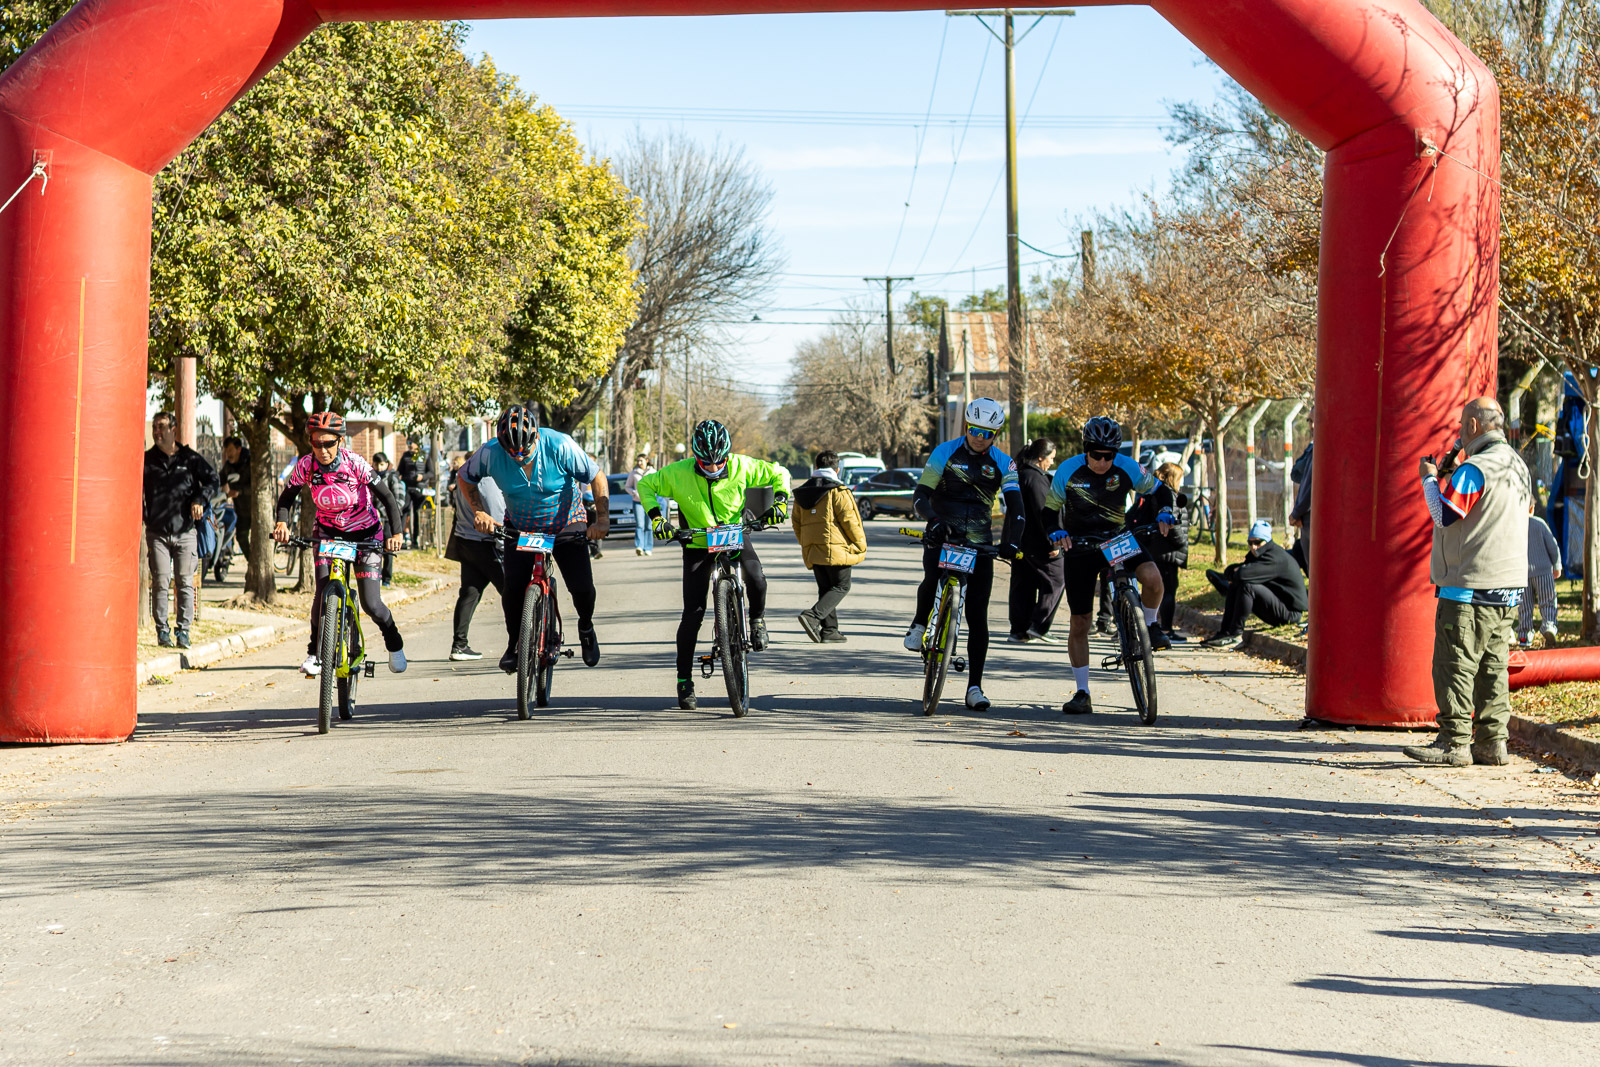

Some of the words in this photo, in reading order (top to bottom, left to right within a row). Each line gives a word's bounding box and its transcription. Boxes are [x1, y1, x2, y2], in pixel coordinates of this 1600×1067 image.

[525, 537, 545, 548] 10
[1110, 538, 1132, 559] 62
[944, 550, 974, 567] 178
